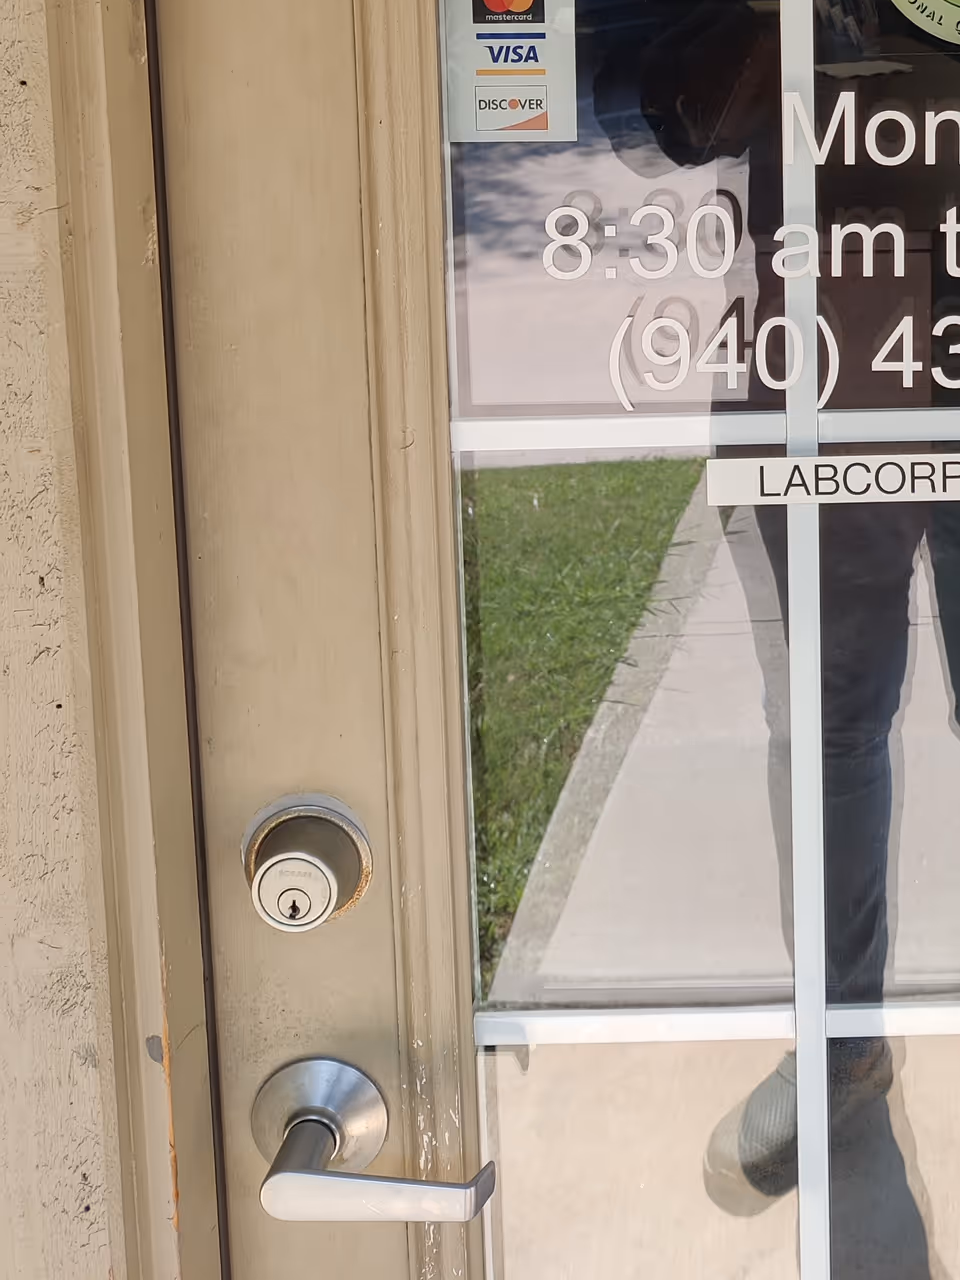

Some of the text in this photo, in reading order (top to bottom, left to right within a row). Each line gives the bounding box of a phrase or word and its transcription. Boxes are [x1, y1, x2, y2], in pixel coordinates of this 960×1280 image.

[485, 13, 533, 21] mastercard
[483, 44, 540, 64] VISA
[478, 98, 544, 111] DISCOVER
[542, 204, 737, 280] 8:30
[770, 221, 906, 279] am
[608, 315, 841, 412] (940)
